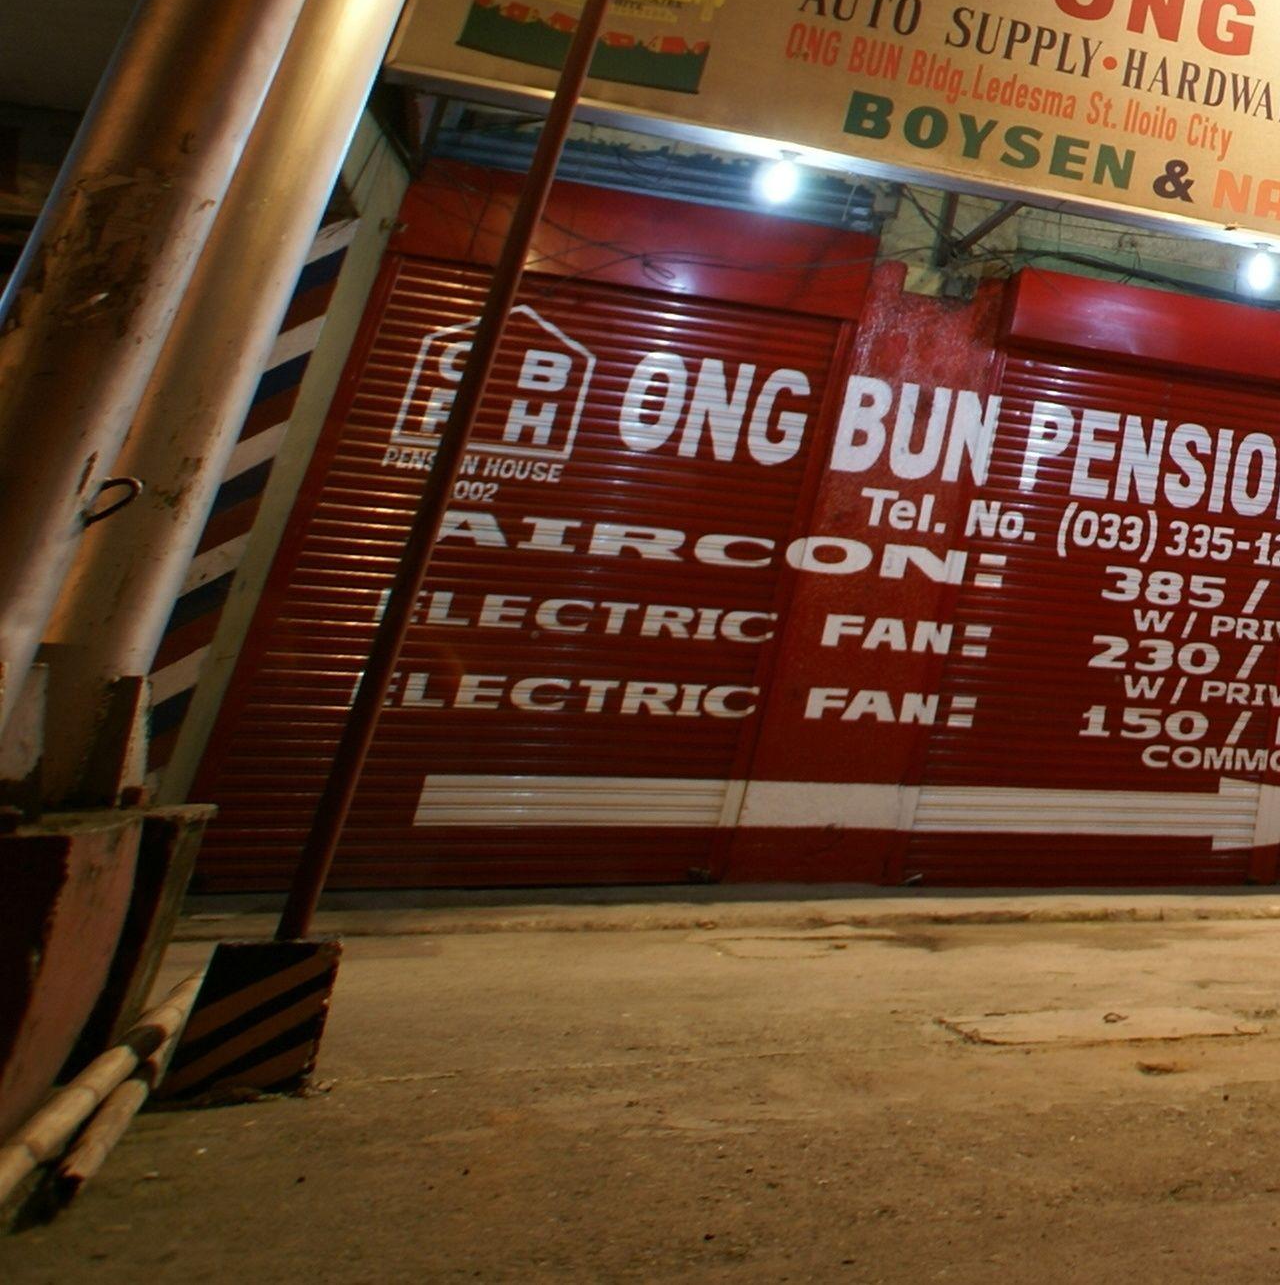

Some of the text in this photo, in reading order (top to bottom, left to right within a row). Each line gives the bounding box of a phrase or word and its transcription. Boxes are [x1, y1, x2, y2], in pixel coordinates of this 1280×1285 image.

[944, 6, 1102, 79] SUPPLY
[785, 22, 1234, 162] ONG BUN Bldg. Ledesma St. Iloilo City
[842, 89, 1136, 191] BOYSEN
[1152, 158, 1195, 206] &
[516, 348, 573, 393] B
[501, 398, 559, 446] H
[618, 351, 811, 467] ONG
[830, 373, 1003, 488] BUN
[381, 446, 565, 484] PENSN HOUSE
[860, 486, 946, 535] Tel.
[964, 498, 1037, 542] No.
[1056, 501, 1160, 564] (033)
[1100, 564, 1226, 609] 385
[1087, 634, 1222, 677] 230
[1078, 704, 1210, 742] 150
